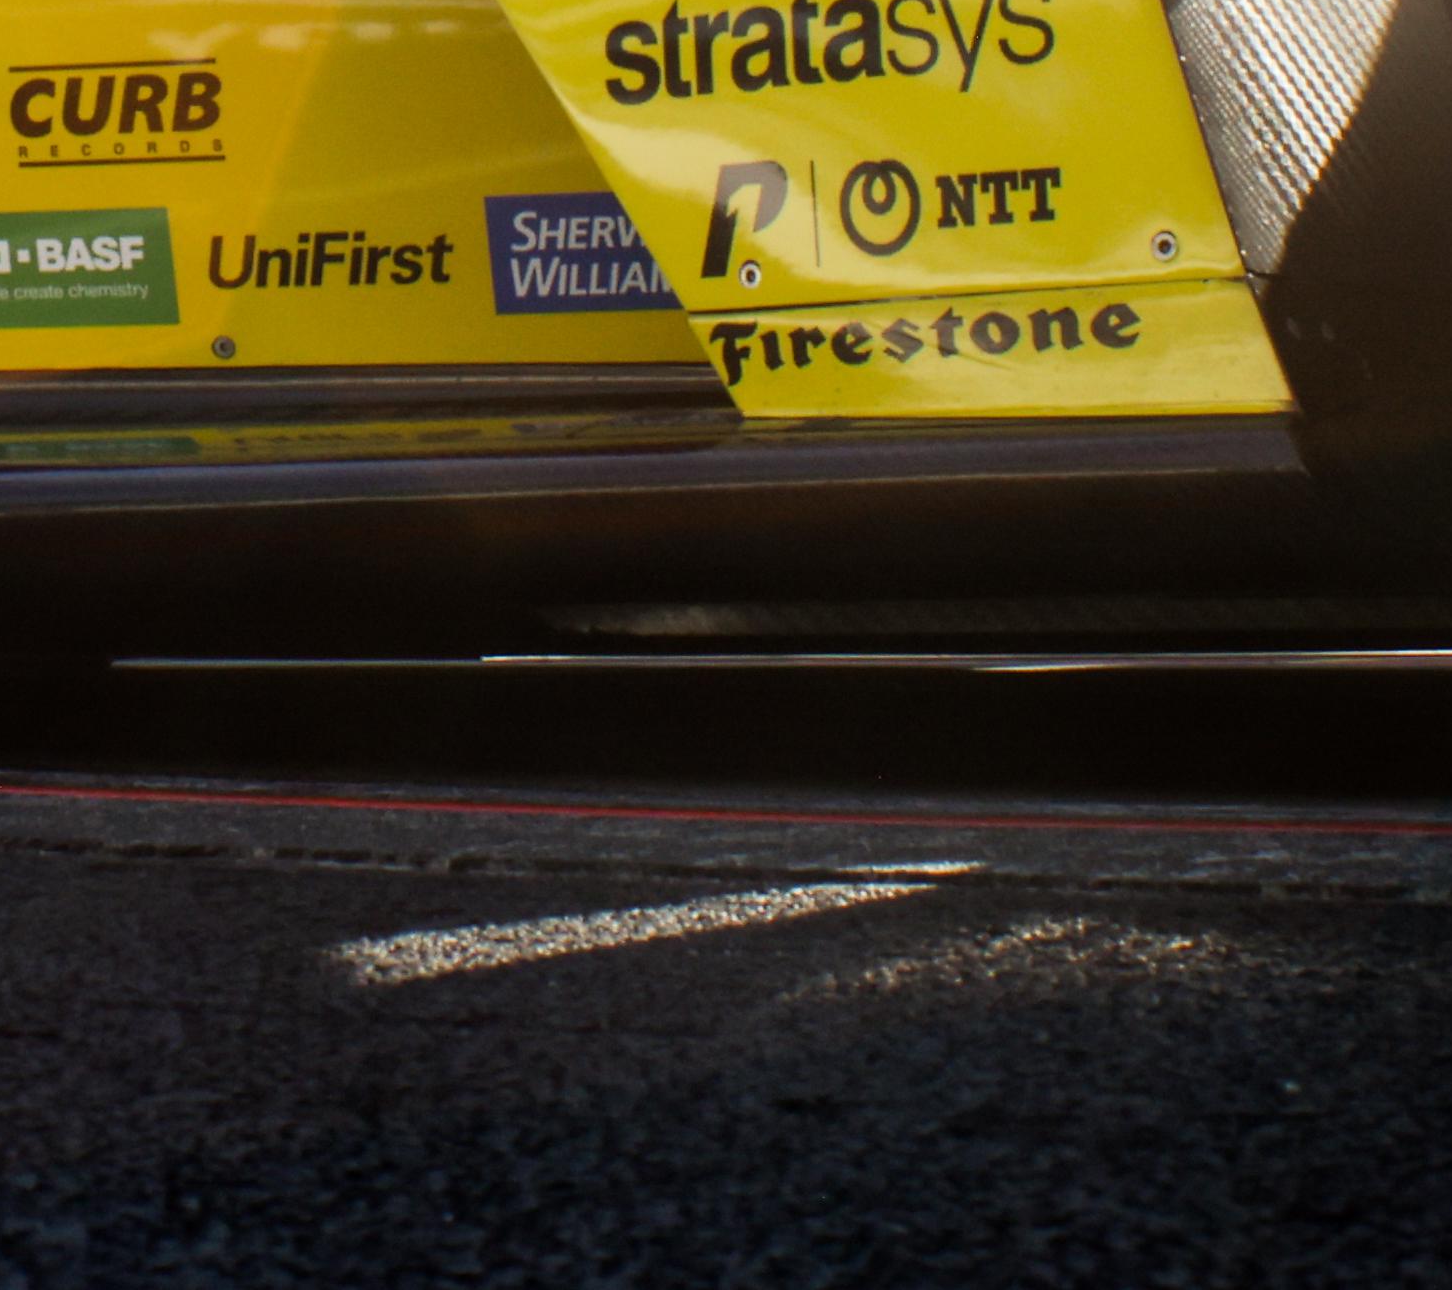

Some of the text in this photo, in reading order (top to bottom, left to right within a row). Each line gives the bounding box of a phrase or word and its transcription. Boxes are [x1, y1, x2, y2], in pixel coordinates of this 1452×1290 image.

[10, 71, 221, 138] CURB
[19, 139, 225, 160] RECORDS
[936, 167, 1061, 228] NTT
[36, 236, 145, 272] BASF
[207, 233, 453, 289] UniFirst
[14, 286, 65, 301] create
[68, 280, 149, 303] chemistry
[708, 302, 1142, 387] Firestone
